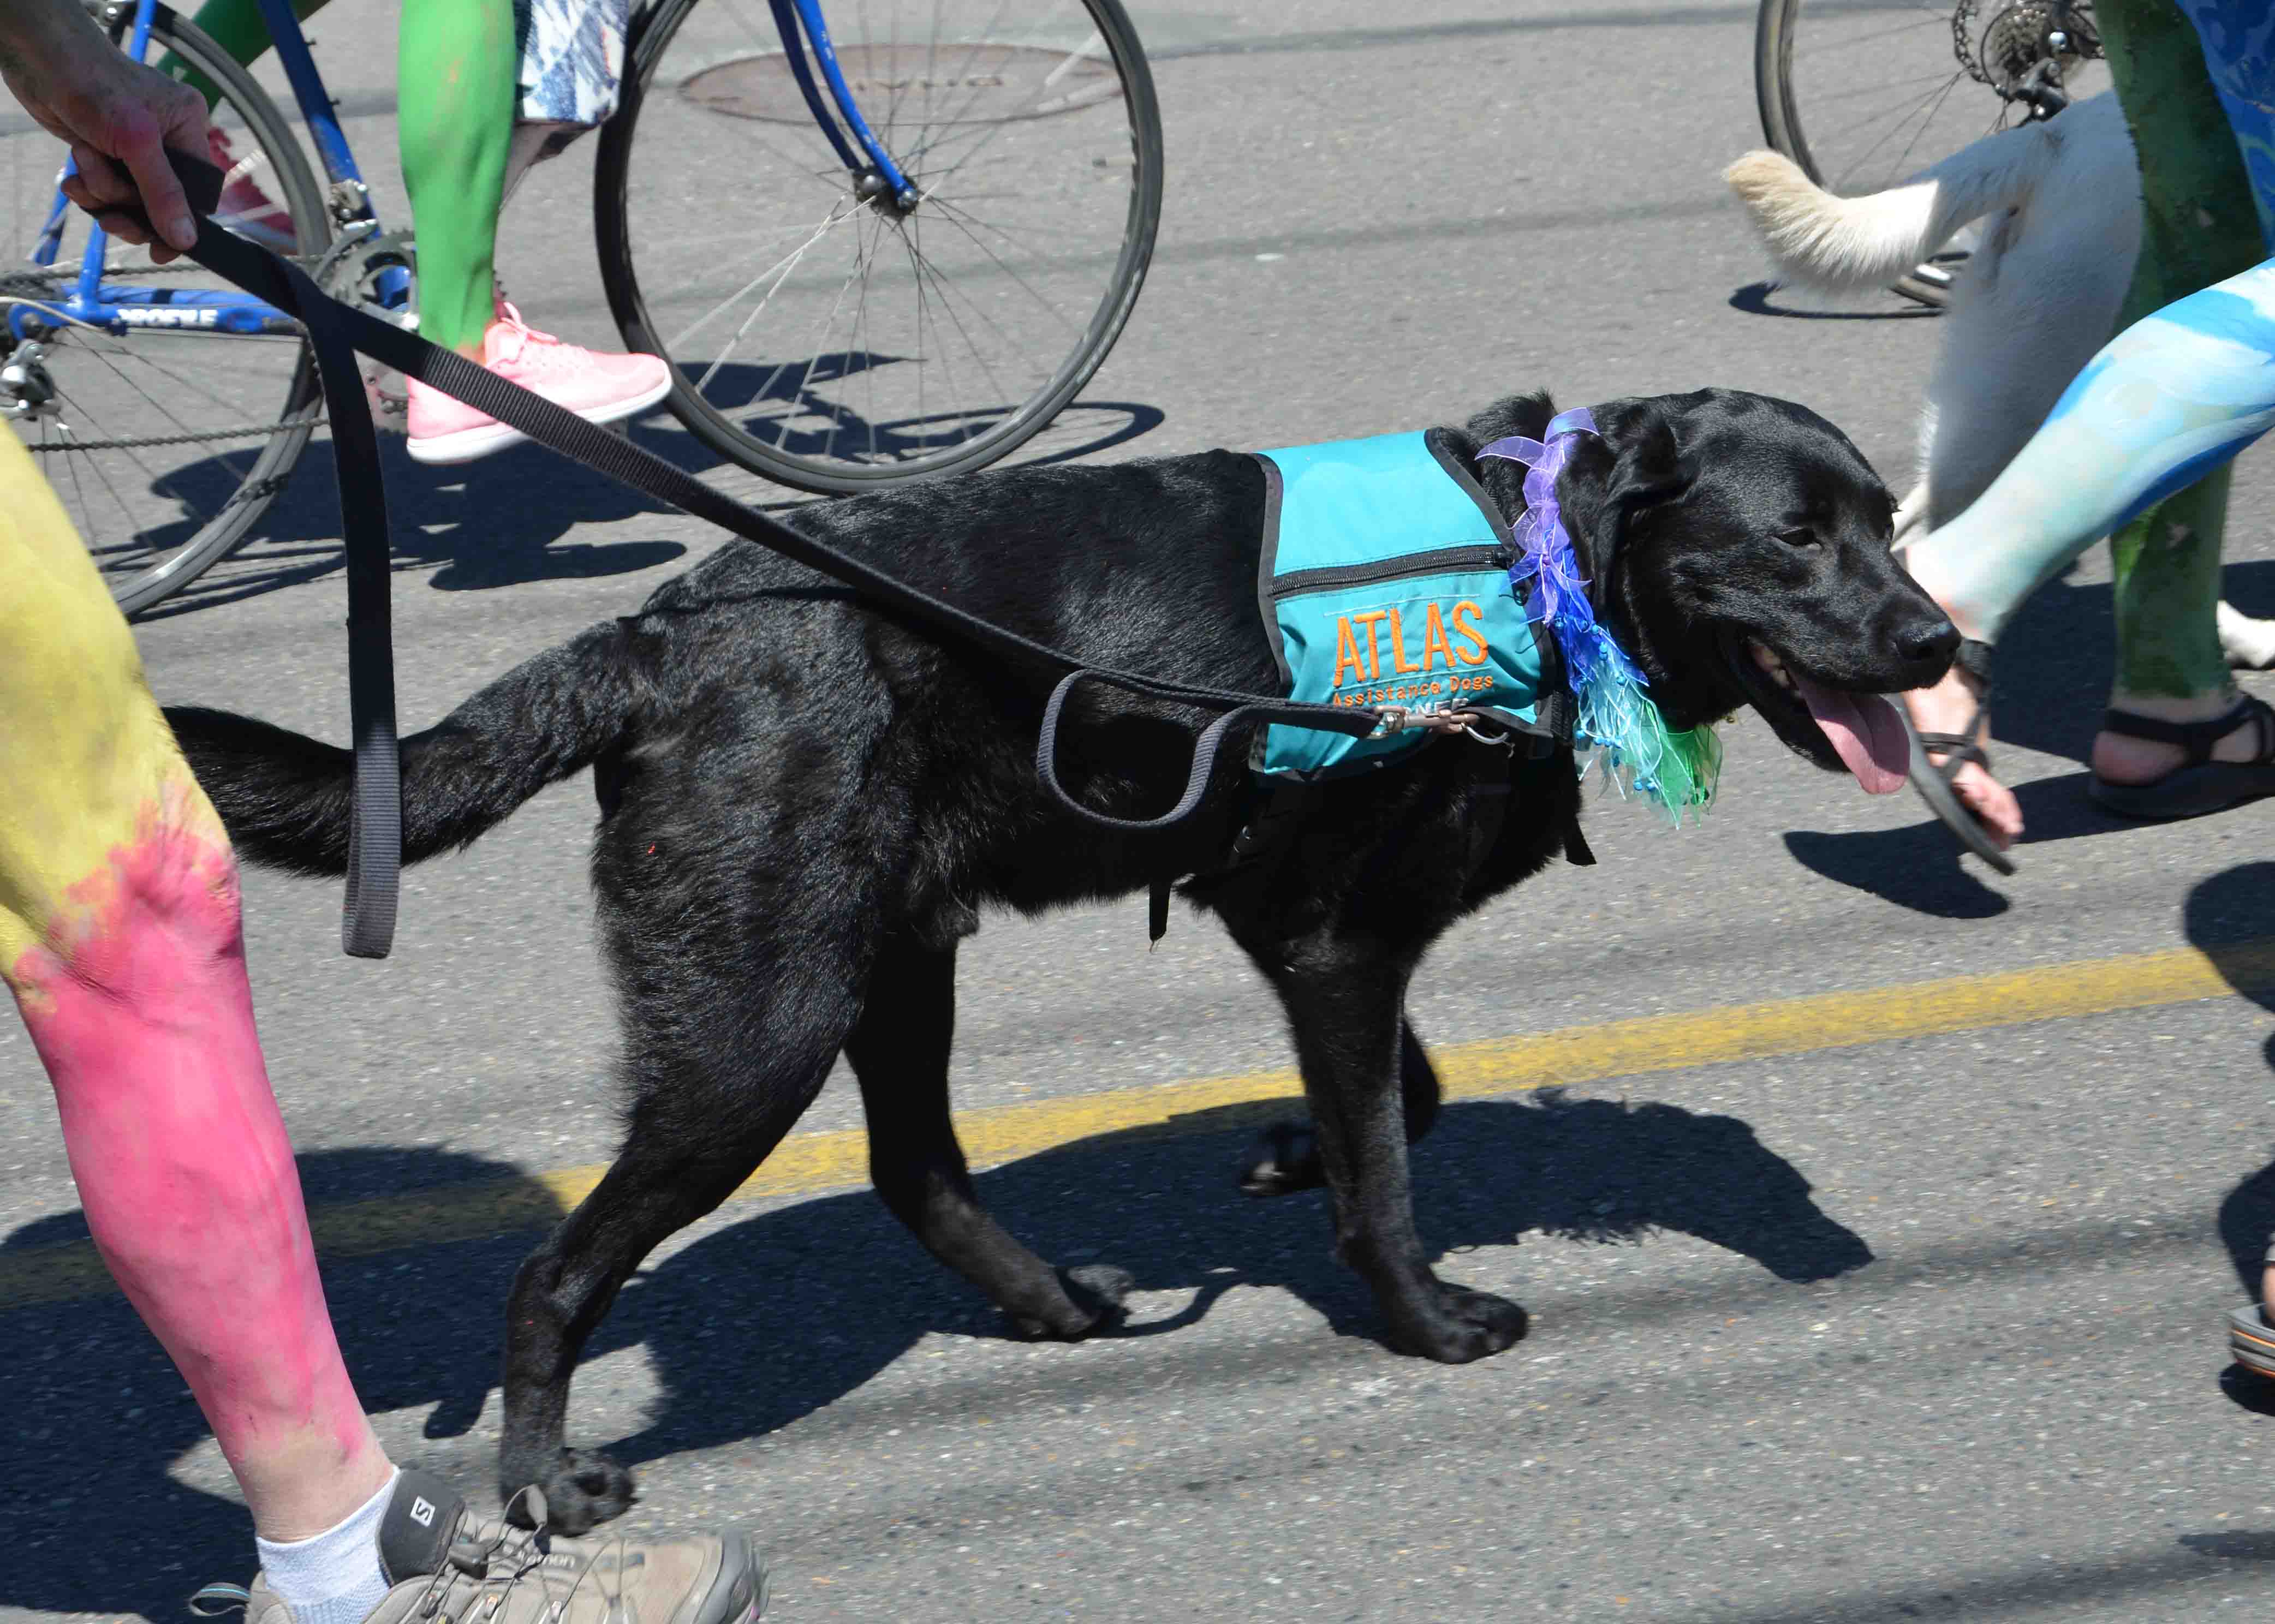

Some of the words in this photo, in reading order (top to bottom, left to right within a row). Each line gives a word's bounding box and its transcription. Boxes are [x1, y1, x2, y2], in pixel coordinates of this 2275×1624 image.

[1333, 600, 1489, 688] ATLAS
[1332, 681, 1442, 707] Assistance
[1449, 674, 1494, 693] Dogs
